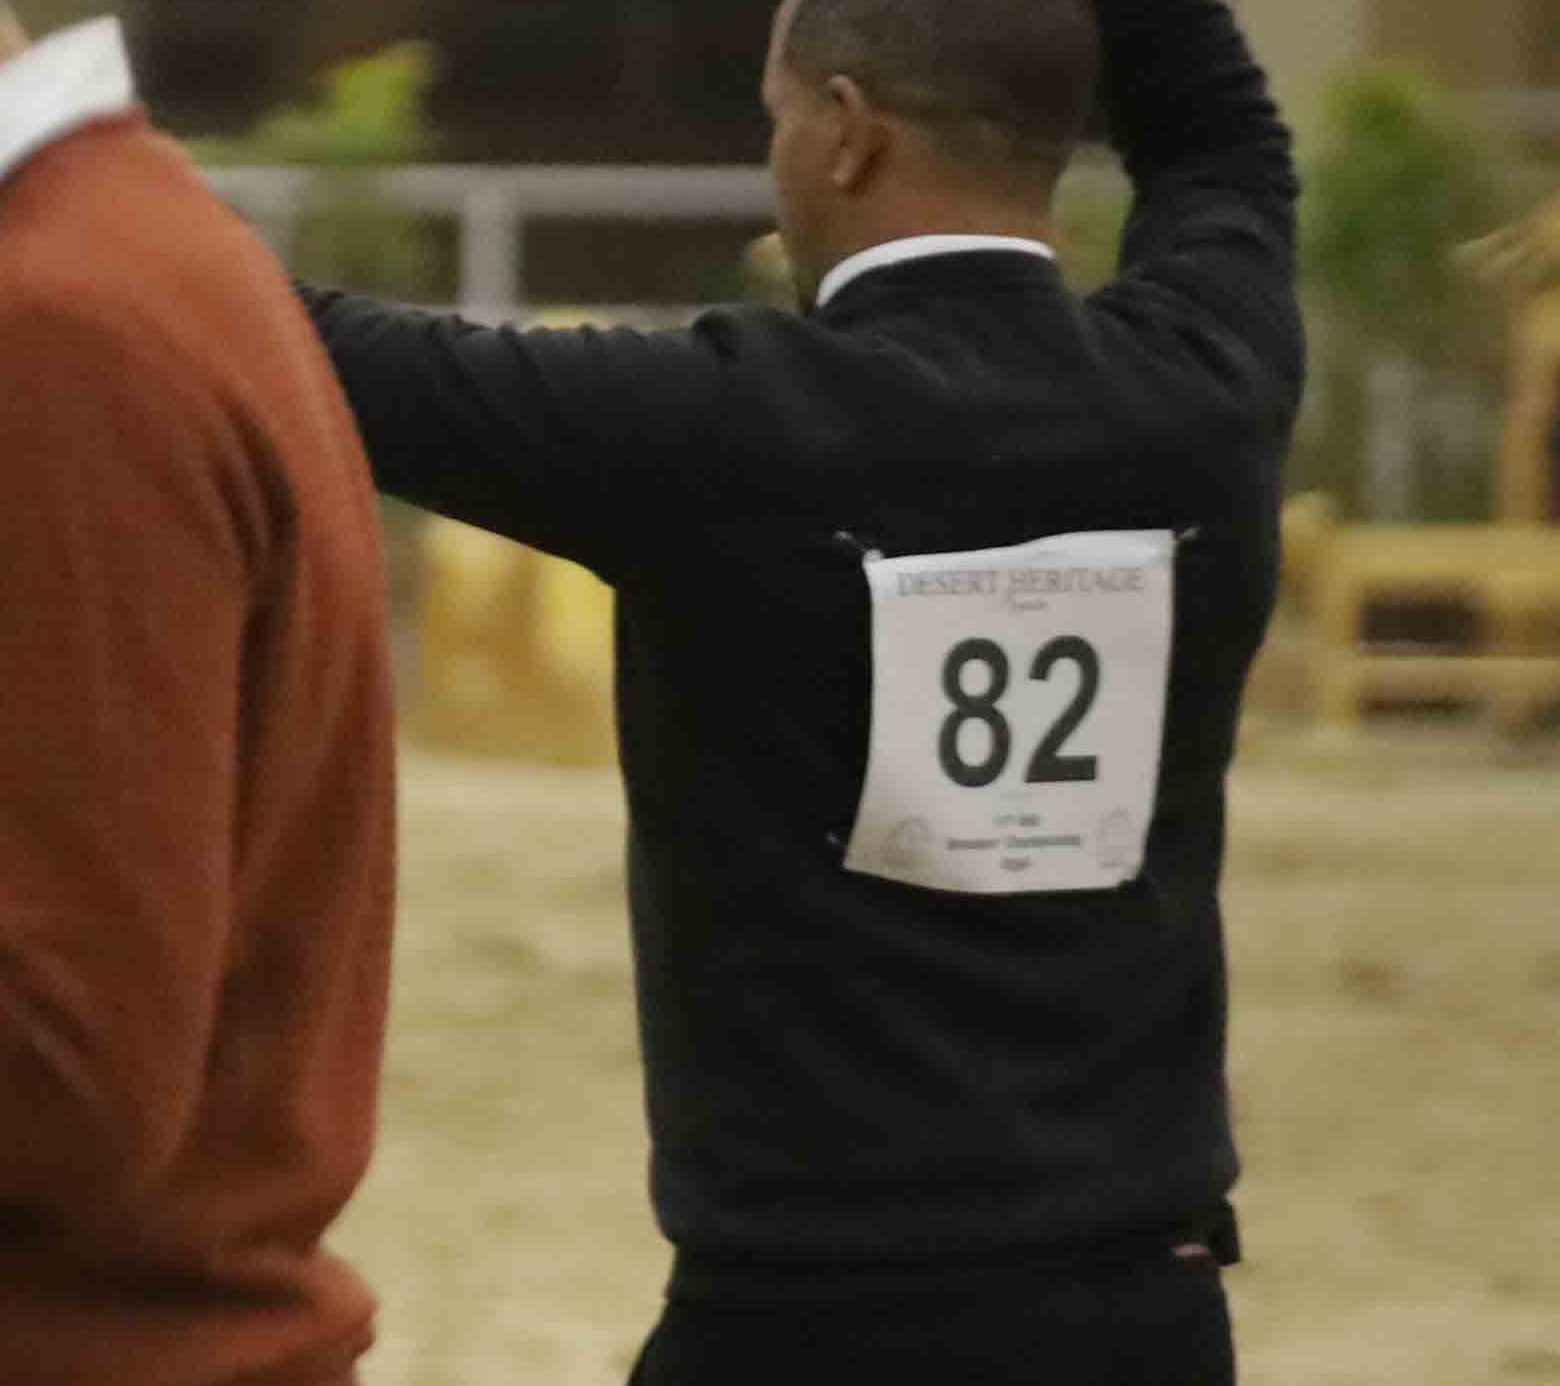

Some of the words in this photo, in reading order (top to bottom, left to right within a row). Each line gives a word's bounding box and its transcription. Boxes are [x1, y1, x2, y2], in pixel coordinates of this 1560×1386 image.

[896, 569, 999, 597] DESERT
[1008, 566, 1145, 595] HERITAGE
[937, 633, 1100, 789] 82
